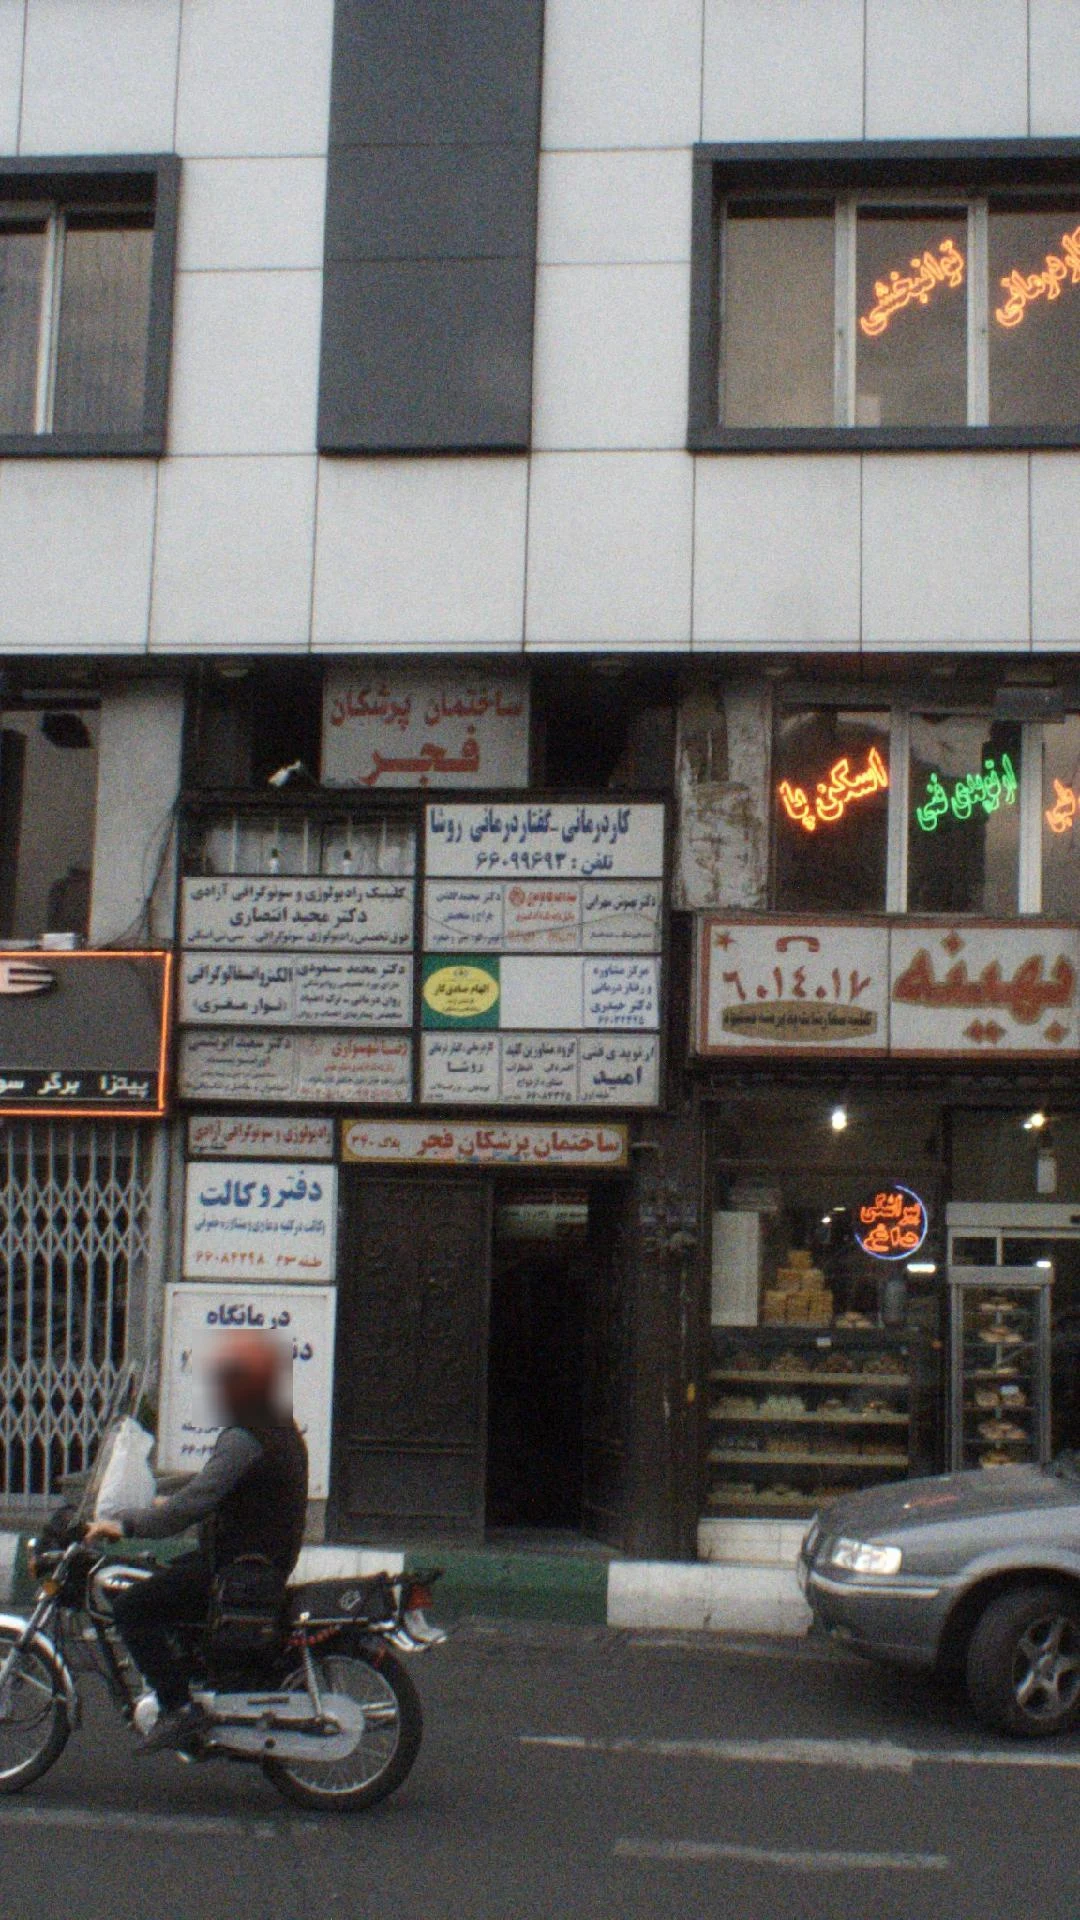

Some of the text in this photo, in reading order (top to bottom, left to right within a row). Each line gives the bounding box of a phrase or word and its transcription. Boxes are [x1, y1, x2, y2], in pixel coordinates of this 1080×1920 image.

[330, 684, 522, 731] ساختمان پزشکان
[358, 726, 479, 785] فجر
[816, 746, 889, 821] اسکن
[916, 772, 949, 832] فنی
[336, 907, 367, 929] دکتر
[37, 1072, 80, 1095] برگر
[99, 1075, 149, 1099] پیتزا
[415, 1127, 454, 1156] فجر
[458, 1131, 529, 1158] پزشکان
[533, 1130, 620, 1158] ساختمان
[199, 1169, 323, 1209] دفتر وکالت
